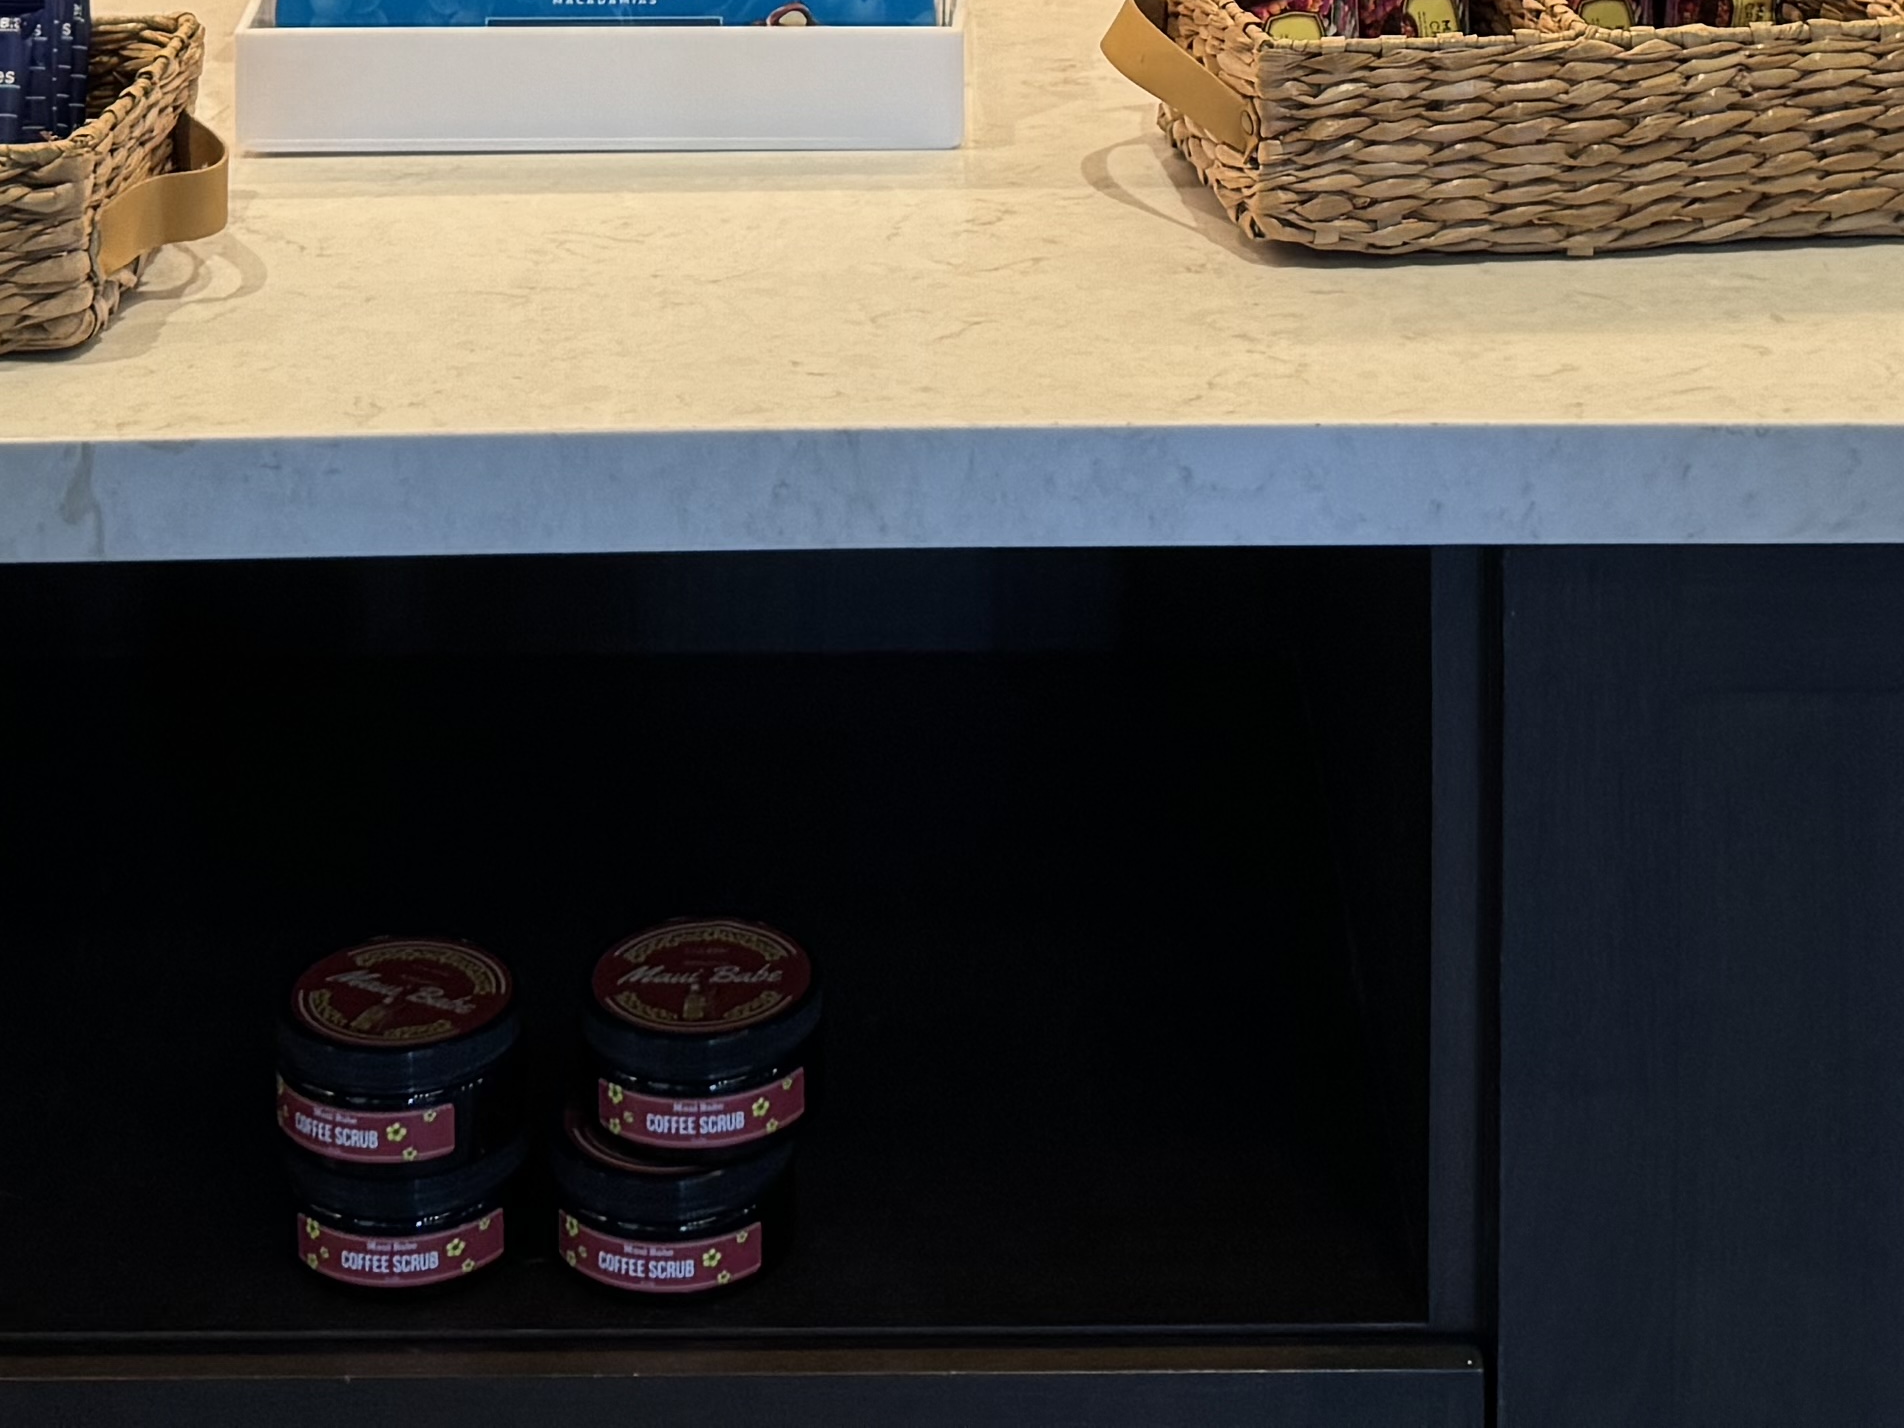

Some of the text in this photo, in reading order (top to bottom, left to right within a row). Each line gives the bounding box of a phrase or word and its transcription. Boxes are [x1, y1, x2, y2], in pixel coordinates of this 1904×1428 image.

[618, 964, 783, 988] Maui Babe
[295, 1112, 379, 1149] COFFEE SCRUB
[645, 1110, 746, 1135] COFFEE SCRUB
[340, 1250, 440, 1274] COFFEE SCRUB
[598, 1252, 696, 1279] COFFEE SCRUB
